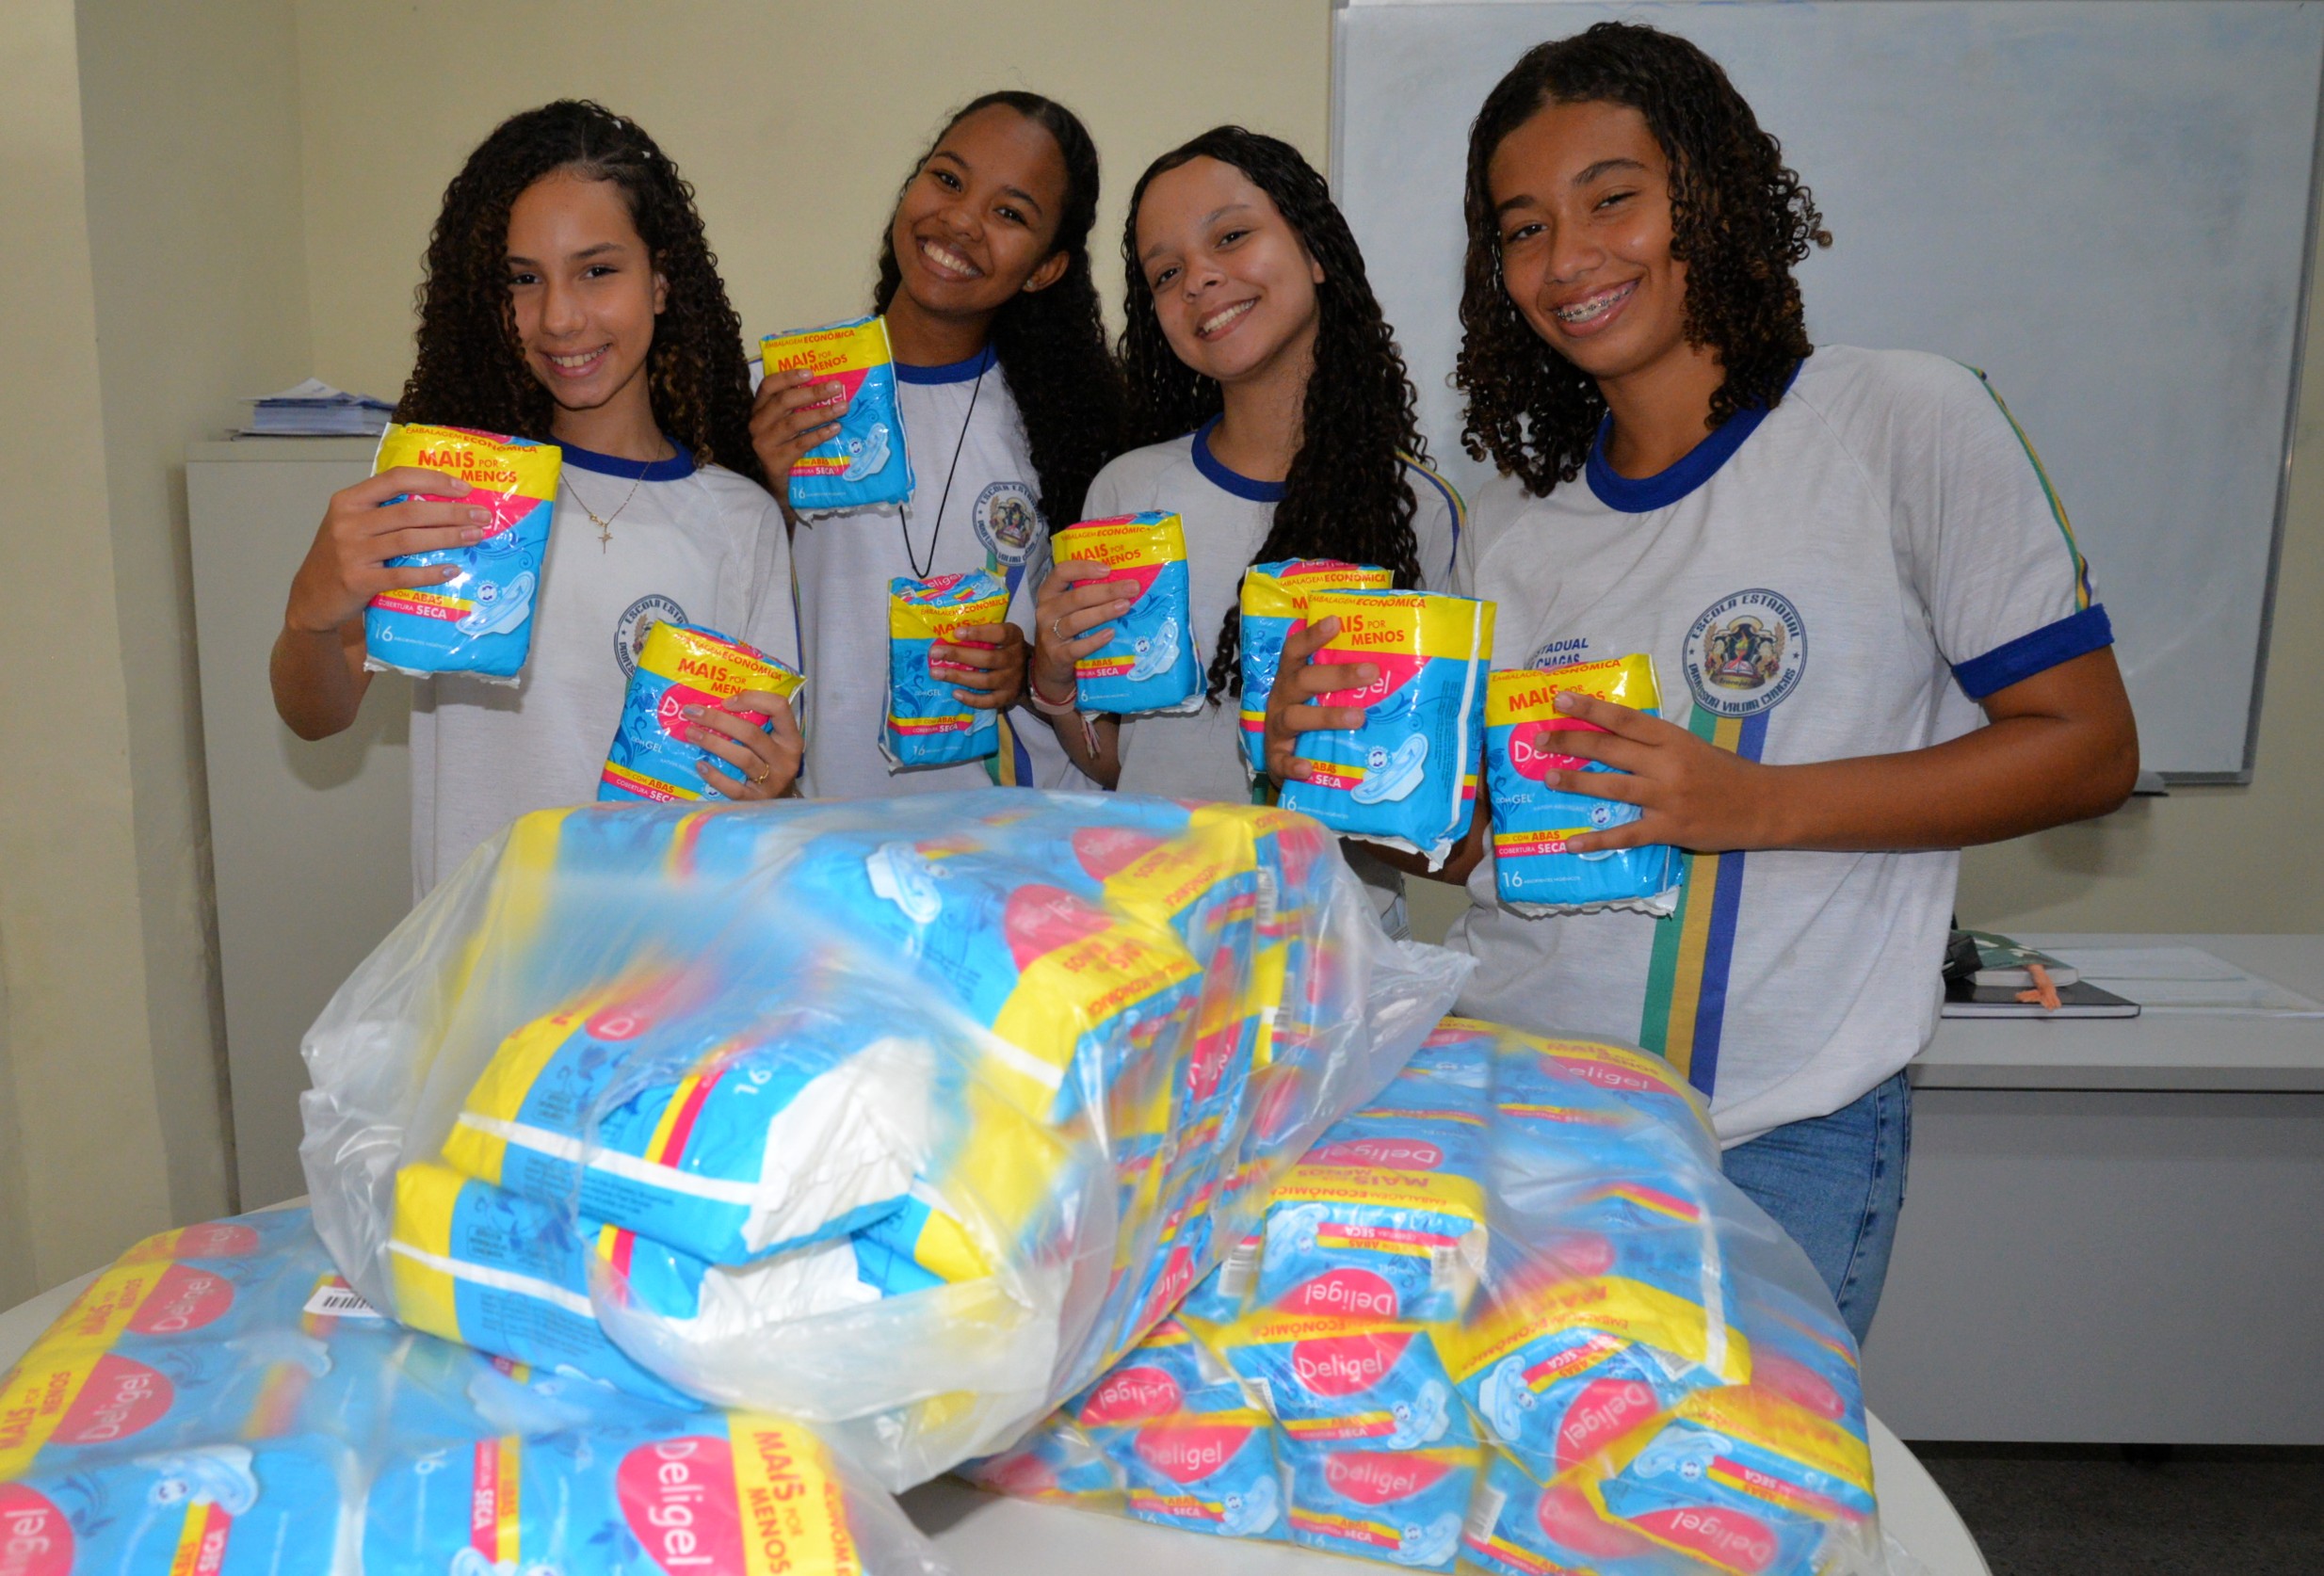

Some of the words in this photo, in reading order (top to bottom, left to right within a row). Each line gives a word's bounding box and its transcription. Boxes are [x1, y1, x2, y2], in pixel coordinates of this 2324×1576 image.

[803, 330, 855, 344] ECONÔMICA
[778, 349, 816, 372] MAIS
[818, 351, 832, 361] POR
[810, 354, 847, 373] MENOS
[462, 436, 538, 454] ECONÔMICA
[418, 450, 475, 468] MAIS
[478, 458, 499, 468] POR
[460, 471, 517, 483] MENOS
[815, 467, 835, 475] SECA
[792, 487, 806, 499] 16
[1071, 543, 1108, 561] MAIS
[1110, 544, 1124, 554] POR
[1101, 549, 1141, 565] MENOS
[1324, 573, 1386, 584] ECONÔMICA
[412, 592, 443, 605] ABAS
[1308, 594, 1356, 604] EMBALAGEM
[1356, 597, 1426, 608] ECONÔMICA
[378, 599, 414, 611] COBERTURA
[416, 604, 447, 619] SECA
[1691, 599, 1737, 639] ESCOLA
[1742, 593, 1799, 637] ESTADUAL
[1338, 615, 1364, 634] AIS
[1367, 620, 1386, 629] POR
[1351, 630, 1405, 646] MENOS
[1537, 637, 1589, 654] TADUAL
[677, 658, 727, 682] MAIS
[729, 675, 747, 684] POR
[722, 651, 783, 682] ECONÔMICA
[1096, 667, 1119, 677] SECA
[710, 681, 745, 694] MEN
[1509, 684, 1559, 712] MAIS
[939, 724, 959, 732] SECA
[645, 741, 663, 753] GEL
[1313, 762, 1336, 774] ABAS
[616, 779, 648, 795] COBERTURA
[632, 774, 647, 784] COM
[649, 780, 674, 794] ABAS
[1315, 774, 1342, 788] SECA
[1281, 794, 1297, 811] 16
[1512, 793, 1533, 804] GEL
[1531, 830, 1560, 841] ABAS
[1498, 845, 1535, 855] COBERTURA
[1538, 843, 1567, 854] SECA
[1502, 871, 1523, 888] 16
[734, 1069, 772, 1095] 16
[1569, 1066, 1648, 1089] eligel
[1270, 1185, 1368, 1199] ECONÔMICA
[1369, 1192, 1446, 1206] EMBALAGEM
[1345, 1226, 1376, 1238] SECA
[1348, 1239, 1380, 1249] ABAS
[1305, 1279, 1394, 1315] Deligel
[1298, 1350, 1383, 1382] Deligel
[1547, 1350, 1578, 1370] SECA
[1558, 1360, 1589, 1378] ABAS
[1564, 1383, 1652, 1449] Deligel
[1337, 1426, 1368, 1439] SECA
[753, 1431, 806, 1502] MAIS
[783, 1507, 804, 1537] POR
[1329, 1459, 1417, 1495] Deligel
[1744, 1468, 1779, 1489] SECA
[473, 1488, 494, 1531] SECA
[648, 1441, 714, 1566] Deligel
[1173, 1507, 1202, 1518] SECA
[747, 1488, 792, 1574] MENOS
[1670, 1510, 1772, 1564] Deligel
